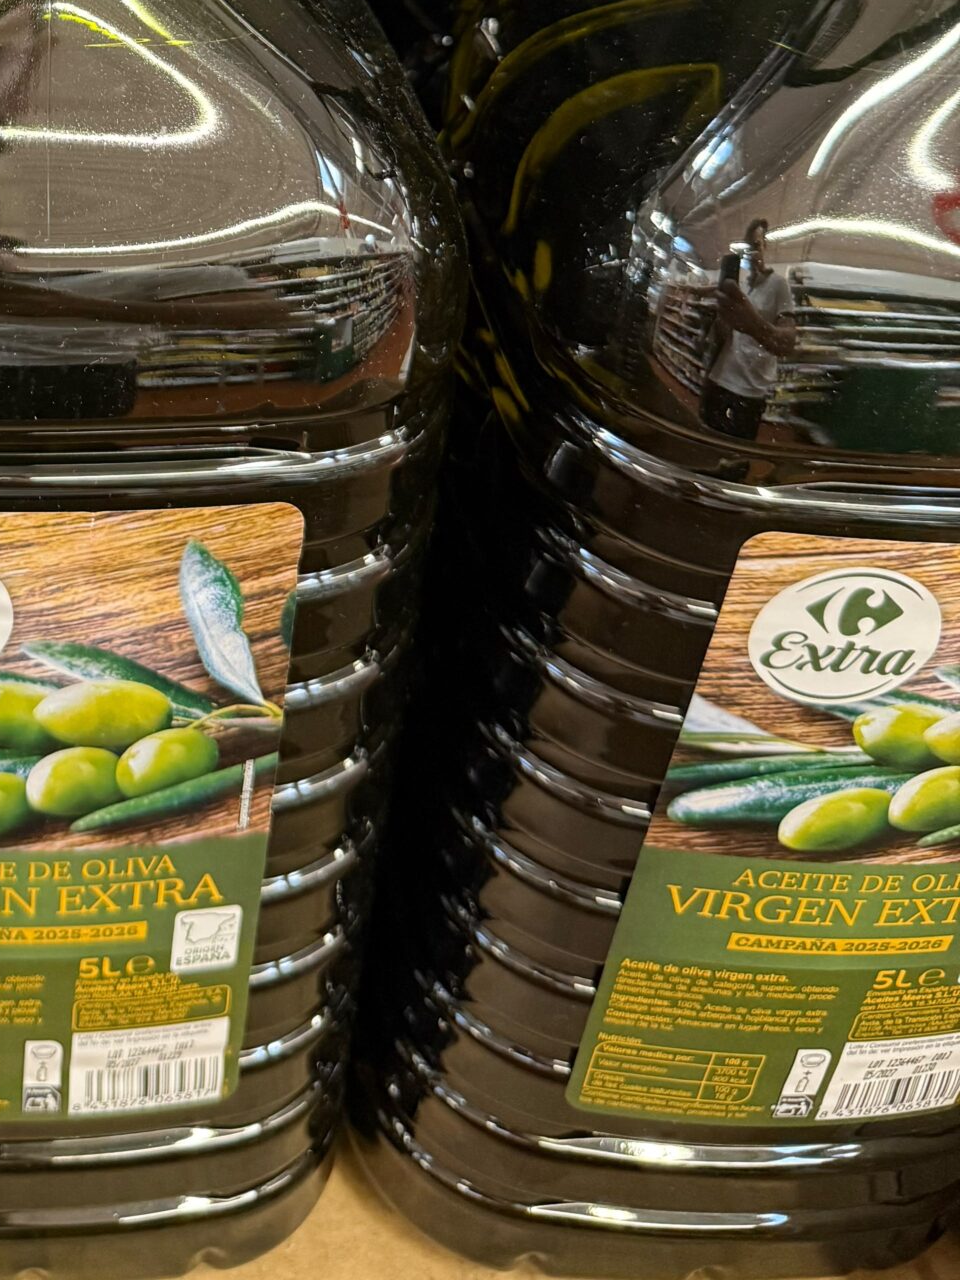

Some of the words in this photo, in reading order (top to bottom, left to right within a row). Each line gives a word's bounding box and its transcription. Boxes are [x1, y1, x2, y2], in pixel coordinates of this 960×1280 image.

[759, 631, 916, 676] Extra
[28, 860, 73, 881] DE
[81, 854, 177, 878] OLIVA
[732, 868, 857, 892] ACEITE
[859, 874, 904, 893] DE
[56, 872, 223, 915] EXTRA
[666, 884, 867, 927] VIRGEN
[35, 926, 139, 942] 2025-2026
[734, 936, 837, 952] CAMPAÑA
[843, 939, 944, 952] 2025-2026
[79, 956, 121, 979] 5L
[175, 950, 231, 966] ESPAÑA
[620, 958, 661, 972] Aceite
[663, 963, 679, 974] de
[682, 966, 712, 978] oliva
[715, 969, 753, 981] virgen
[872, 969, 912, 990] 5L
